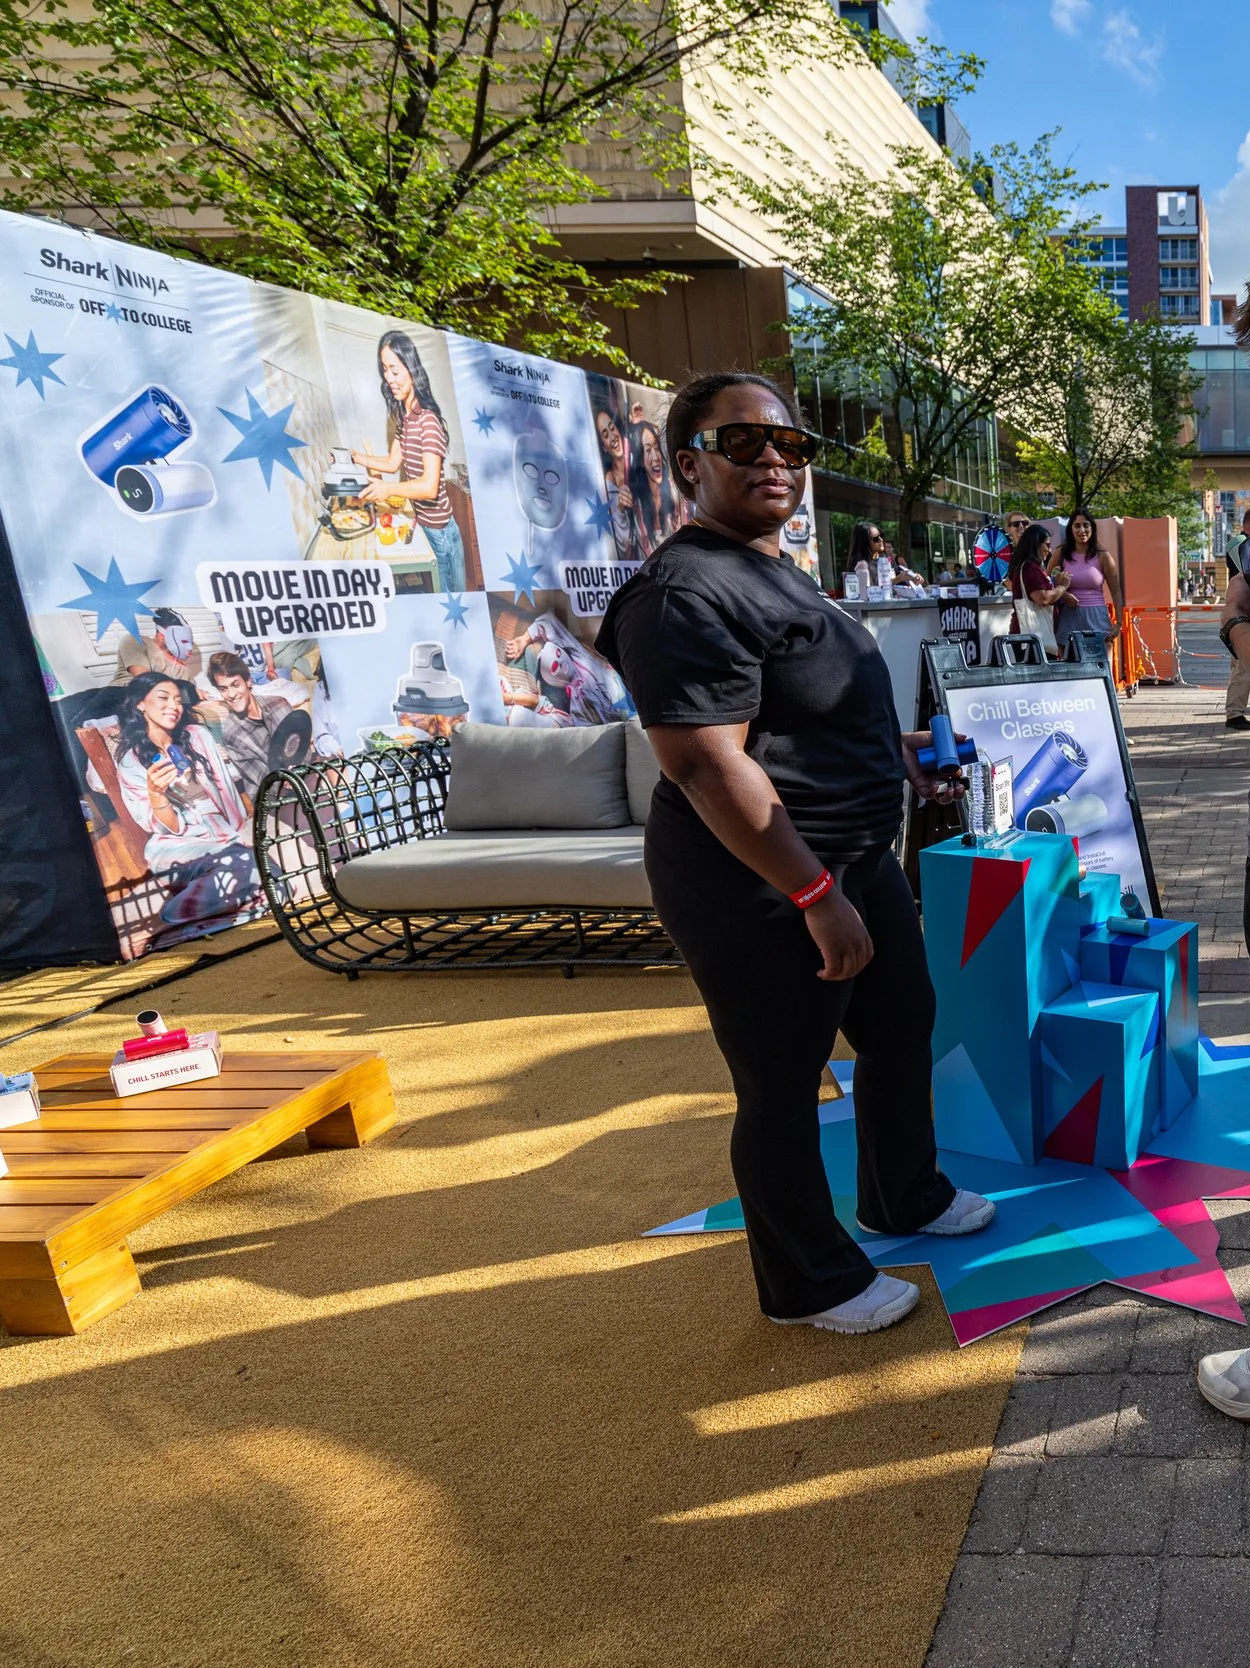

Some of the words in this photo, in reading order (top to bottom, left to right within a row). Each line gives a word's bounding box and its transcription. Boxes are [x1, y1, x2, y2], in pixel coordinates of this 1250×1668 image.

[40, 248, 109, 282] Shark
[114, 264, 170, 297] NINJA
[30, 295, 65, 309] SPONSOR
[34, 288, 66, 301] OFFICIAL
[80, 298, 105, 316] OFF
[120, 307, 139, 323] TO
[142, 312, 193, 334] COLLEGE
[494, 360, 523, 378] Shark
[525, 365, 551, 385] NINJA
[511, 390, 523, 401] OFF
[528, 394, 538, 404] TO
[537, 396, 561, 409] COLLEGE
[113, 432, 134, 451] Shark
[210, 570, 301, 603] MOVE
[302, 569, 331, 599] IN
[332, 568, 390, 599] DAY,
[609, 566, 623, 587] IN
[234, 600, 377, 638] UPGRADED
[941, 606, 977, 631] SHARK
[967, 700, 1011, 722] Chill
[1015, 697, 1096, 718] Between
[1001, 719, 1075, 740] Classes
[1024, 777, 1041, 797] Shark
[127, 1075, 152, 1085] CHILL
[150, 1069, 179, 1080] STARTS
